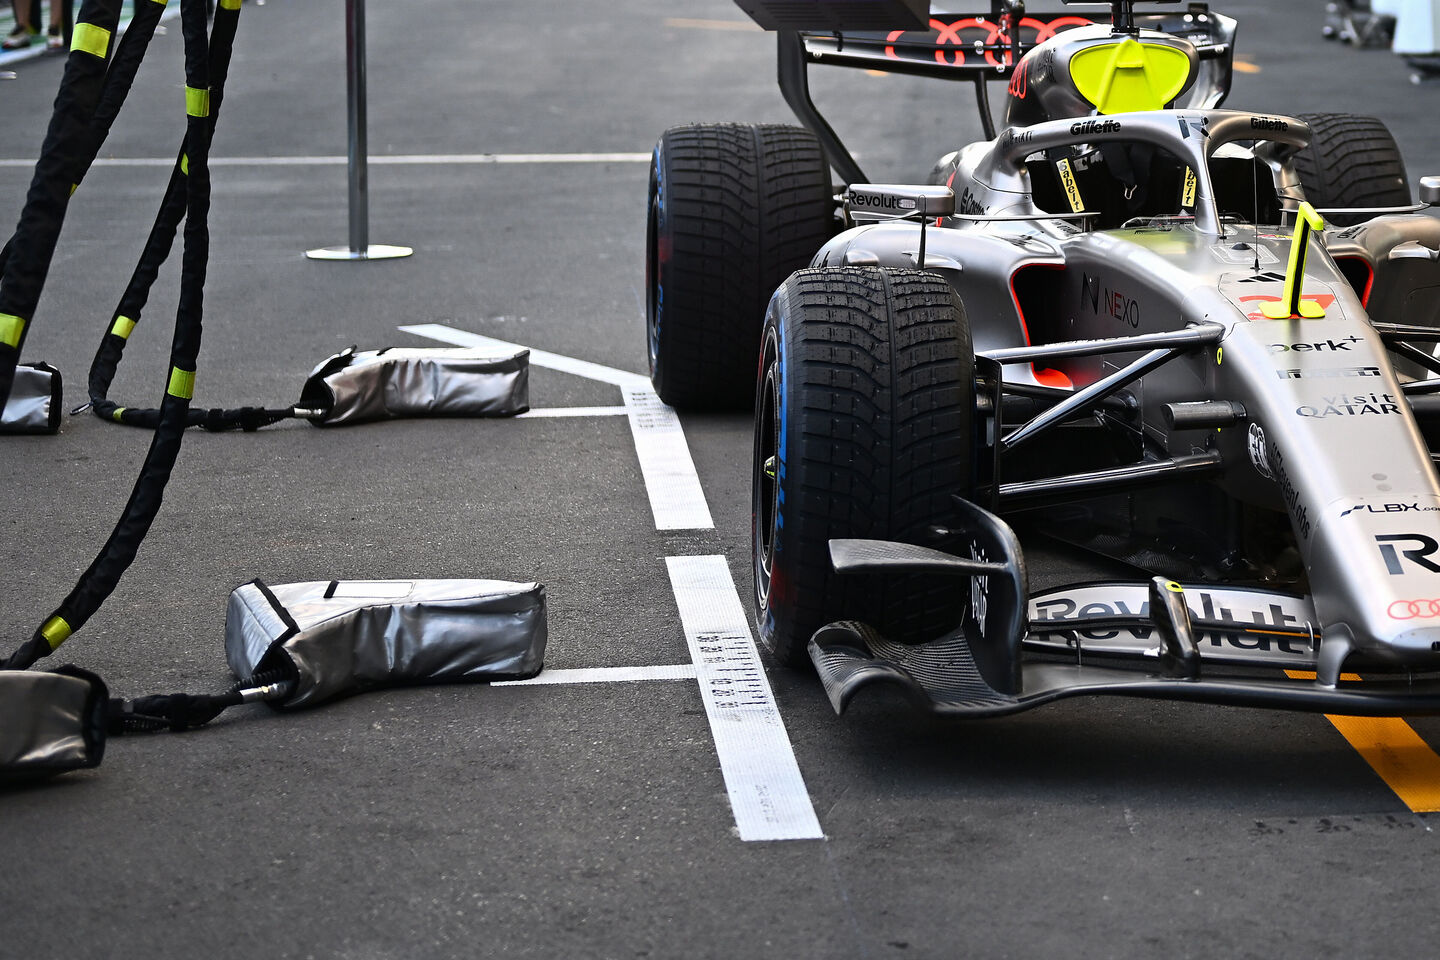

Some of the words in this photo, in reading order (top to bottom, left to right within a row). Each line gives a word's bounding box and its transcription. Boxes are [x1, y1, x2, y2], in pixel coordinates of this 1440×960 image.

[1070, 119, 1121, 136] Gillette
[1250, 116, 1289, 132] Gillette
[1058, 160, 1081, 211] Sabelt
[849, 190, 899, 209] Revolut
[1104, 288, 1140, 329] NEXO
[1322, 393, 1396, 406] visit
[1296, 403, 1402, 419] QATAR
[1036, 592, 1303, 655] Revlut
